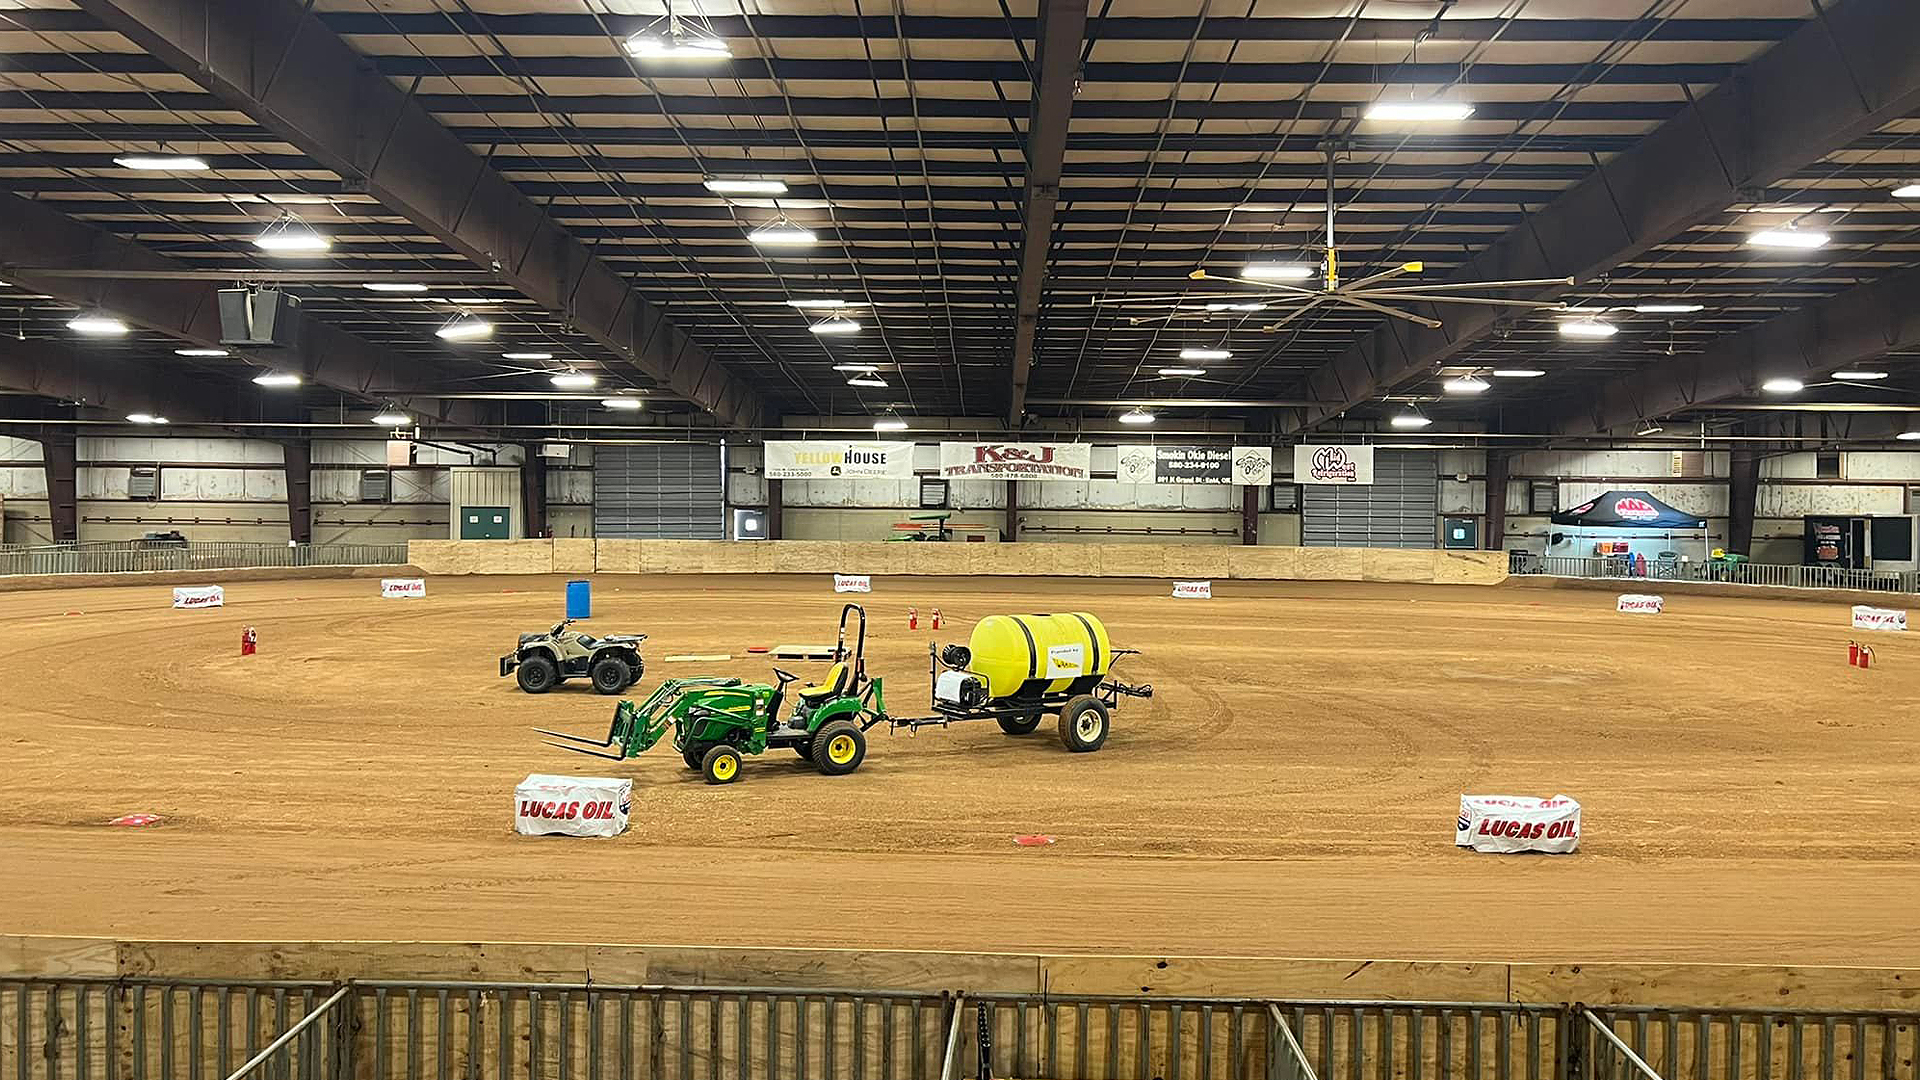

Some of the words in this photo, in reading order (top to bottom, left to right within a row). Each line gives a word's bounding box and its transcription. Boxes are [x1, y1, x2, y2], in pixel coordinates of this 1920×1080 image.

[795, 452, 842, 464] YELLOW
[844, 445, 887, 464] HOUSE
[973, 445, 1056, 463] K&J
[1157, 450, 1186, 460] Smokin
[1187, 450, 1206, 460] Okie
[1207, 450, 1232, 461] Diesel
[945, 462, 1085, 478] TRANSPORTATION
[519, 800, 580, 820] LUCAS
[1477, 818, 1546, 839] LUCAS
